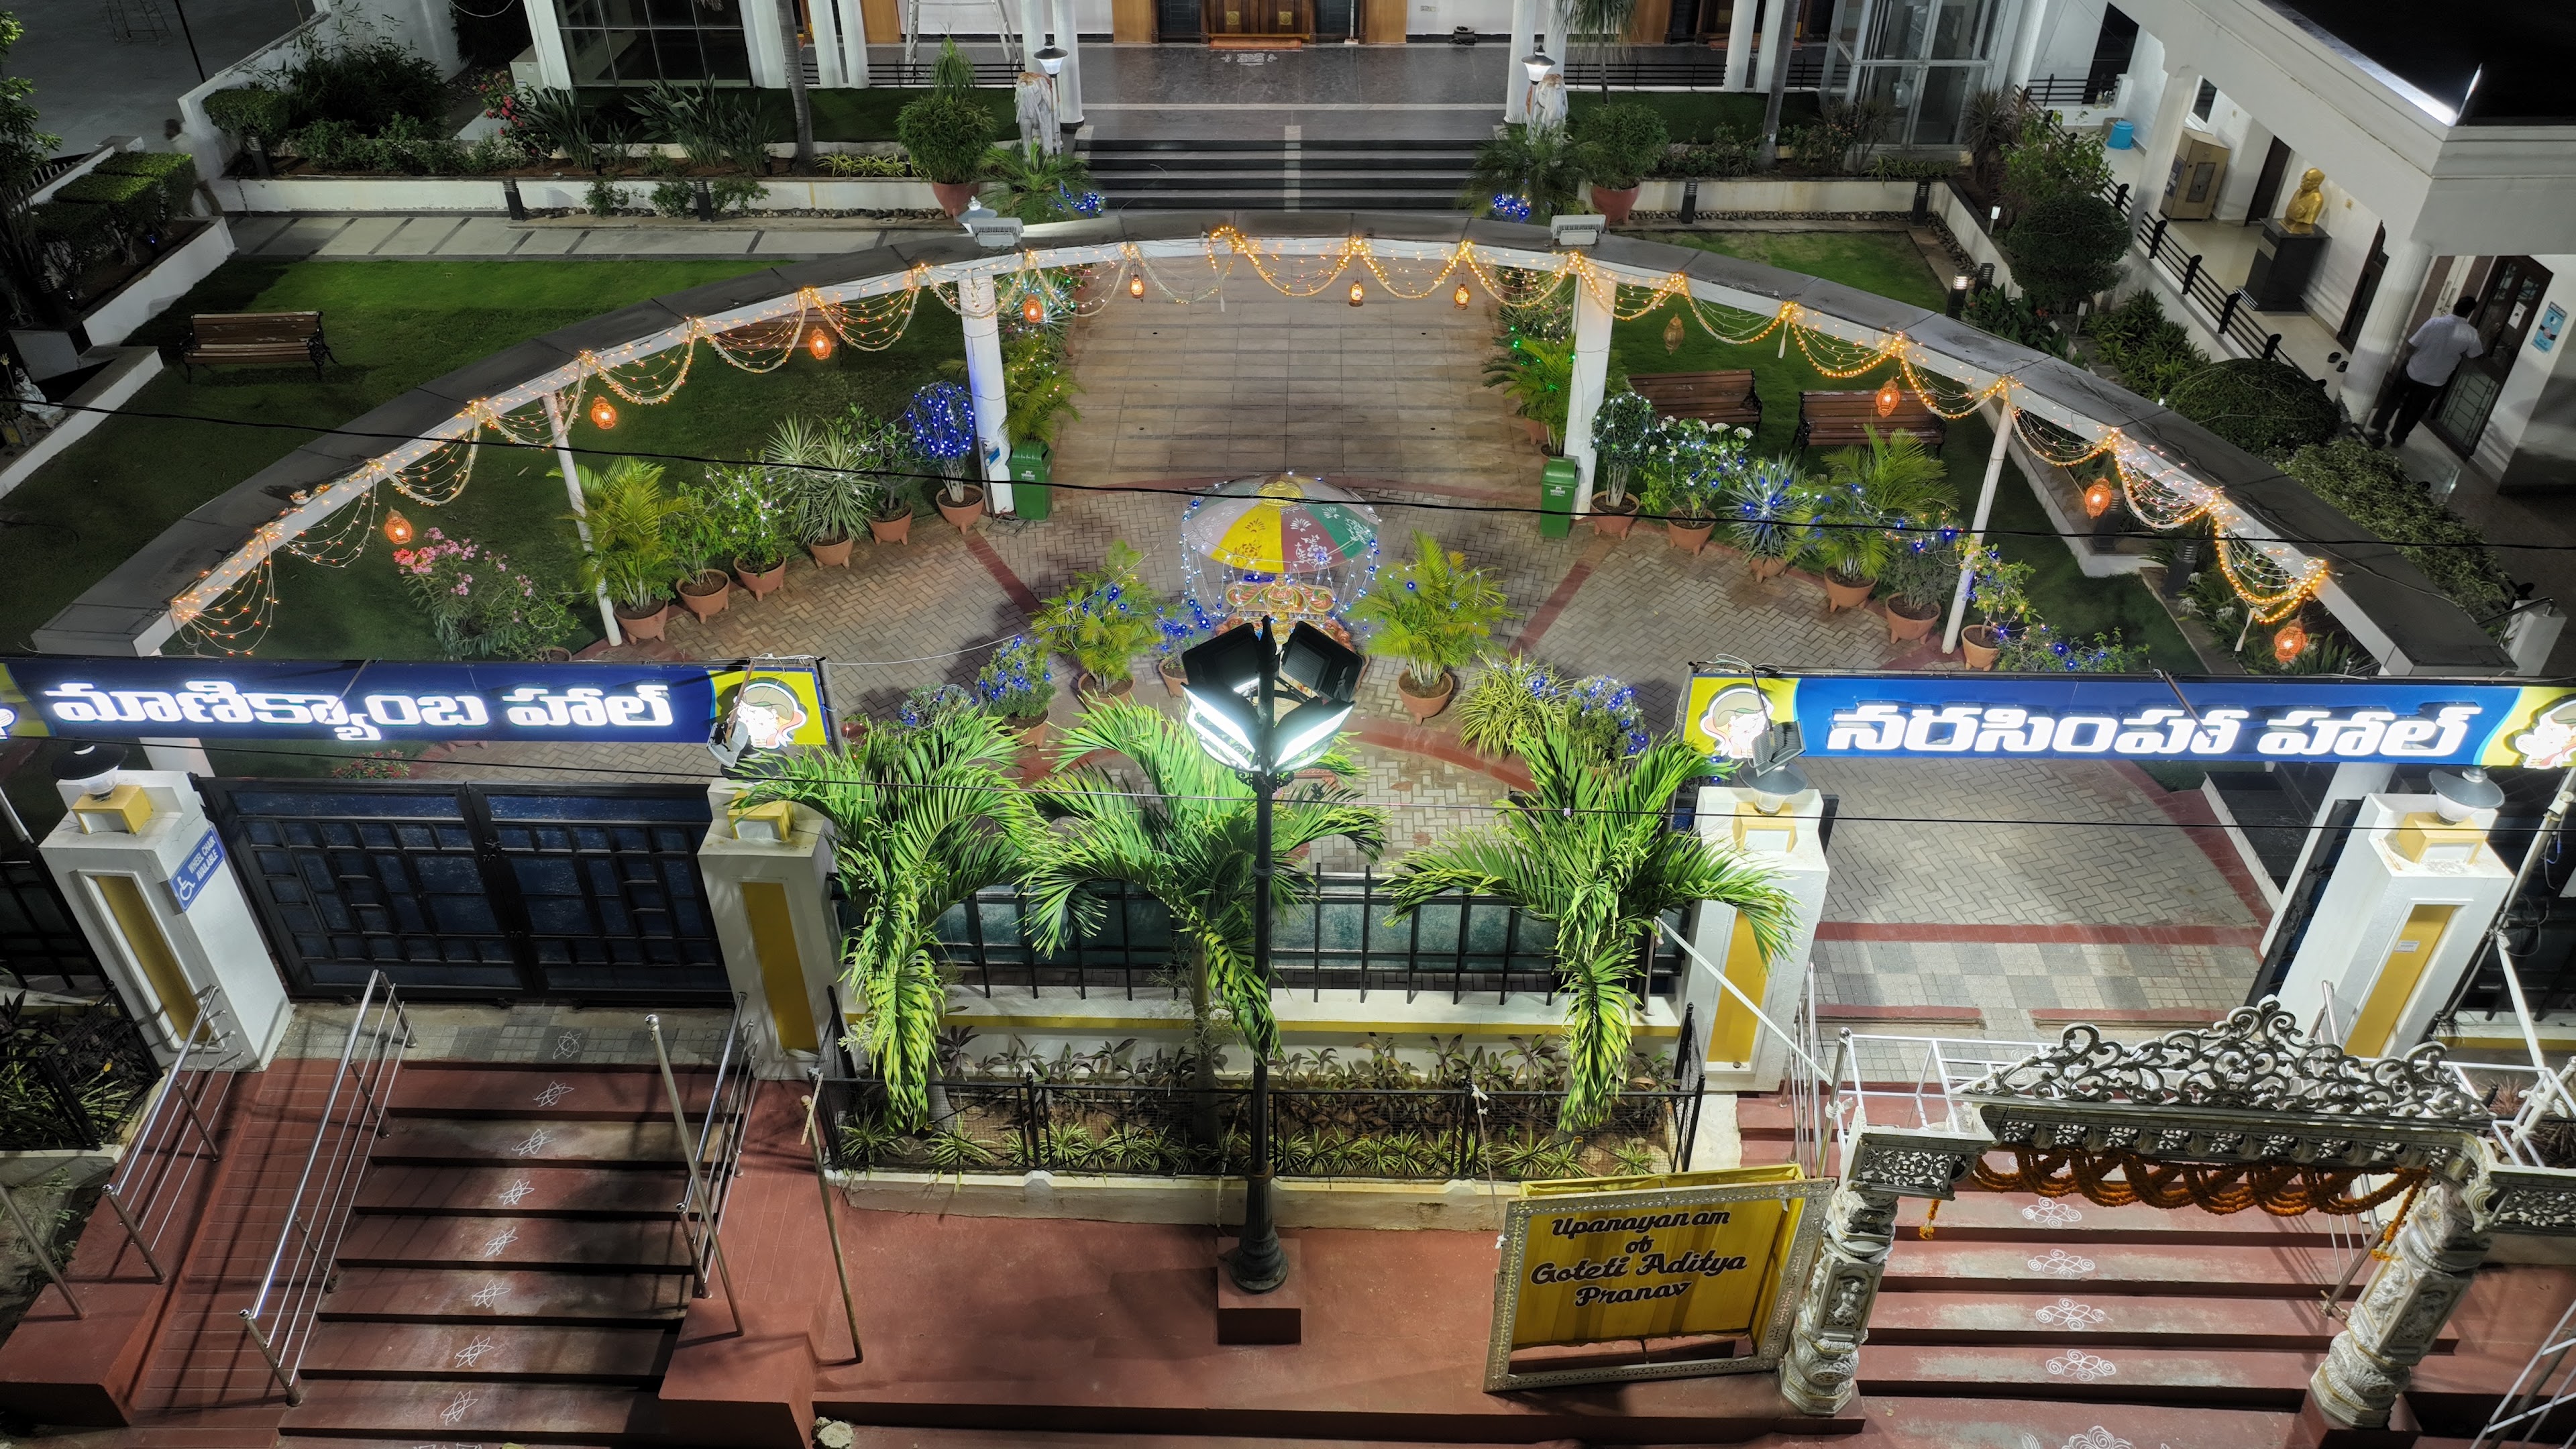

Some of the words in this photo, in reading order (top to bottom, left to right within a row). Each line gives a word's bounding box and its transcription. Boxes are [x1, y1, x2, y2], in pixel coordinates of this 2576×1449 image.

[44, 681, 488, 741] మాణిక్యాంబ
[502, 685, 674, 727] హాల్
[2257, 706, 2483, 757] హాల్
[187, 852, 204, 873] WHEEL
[201, 835, 216, 856] CHAIR
[196, 849, 218, 881] AVAILABLE
[1552, 1212, 1731, 1240] Upanayanam
[1625, 1235, 1654, 1254] of
[1531, 1256, 1630, 1284] Goteti
[1635, 1250, 1747, 1276] Aditya
[1574, 1281, 1692, 1307] Pranav
